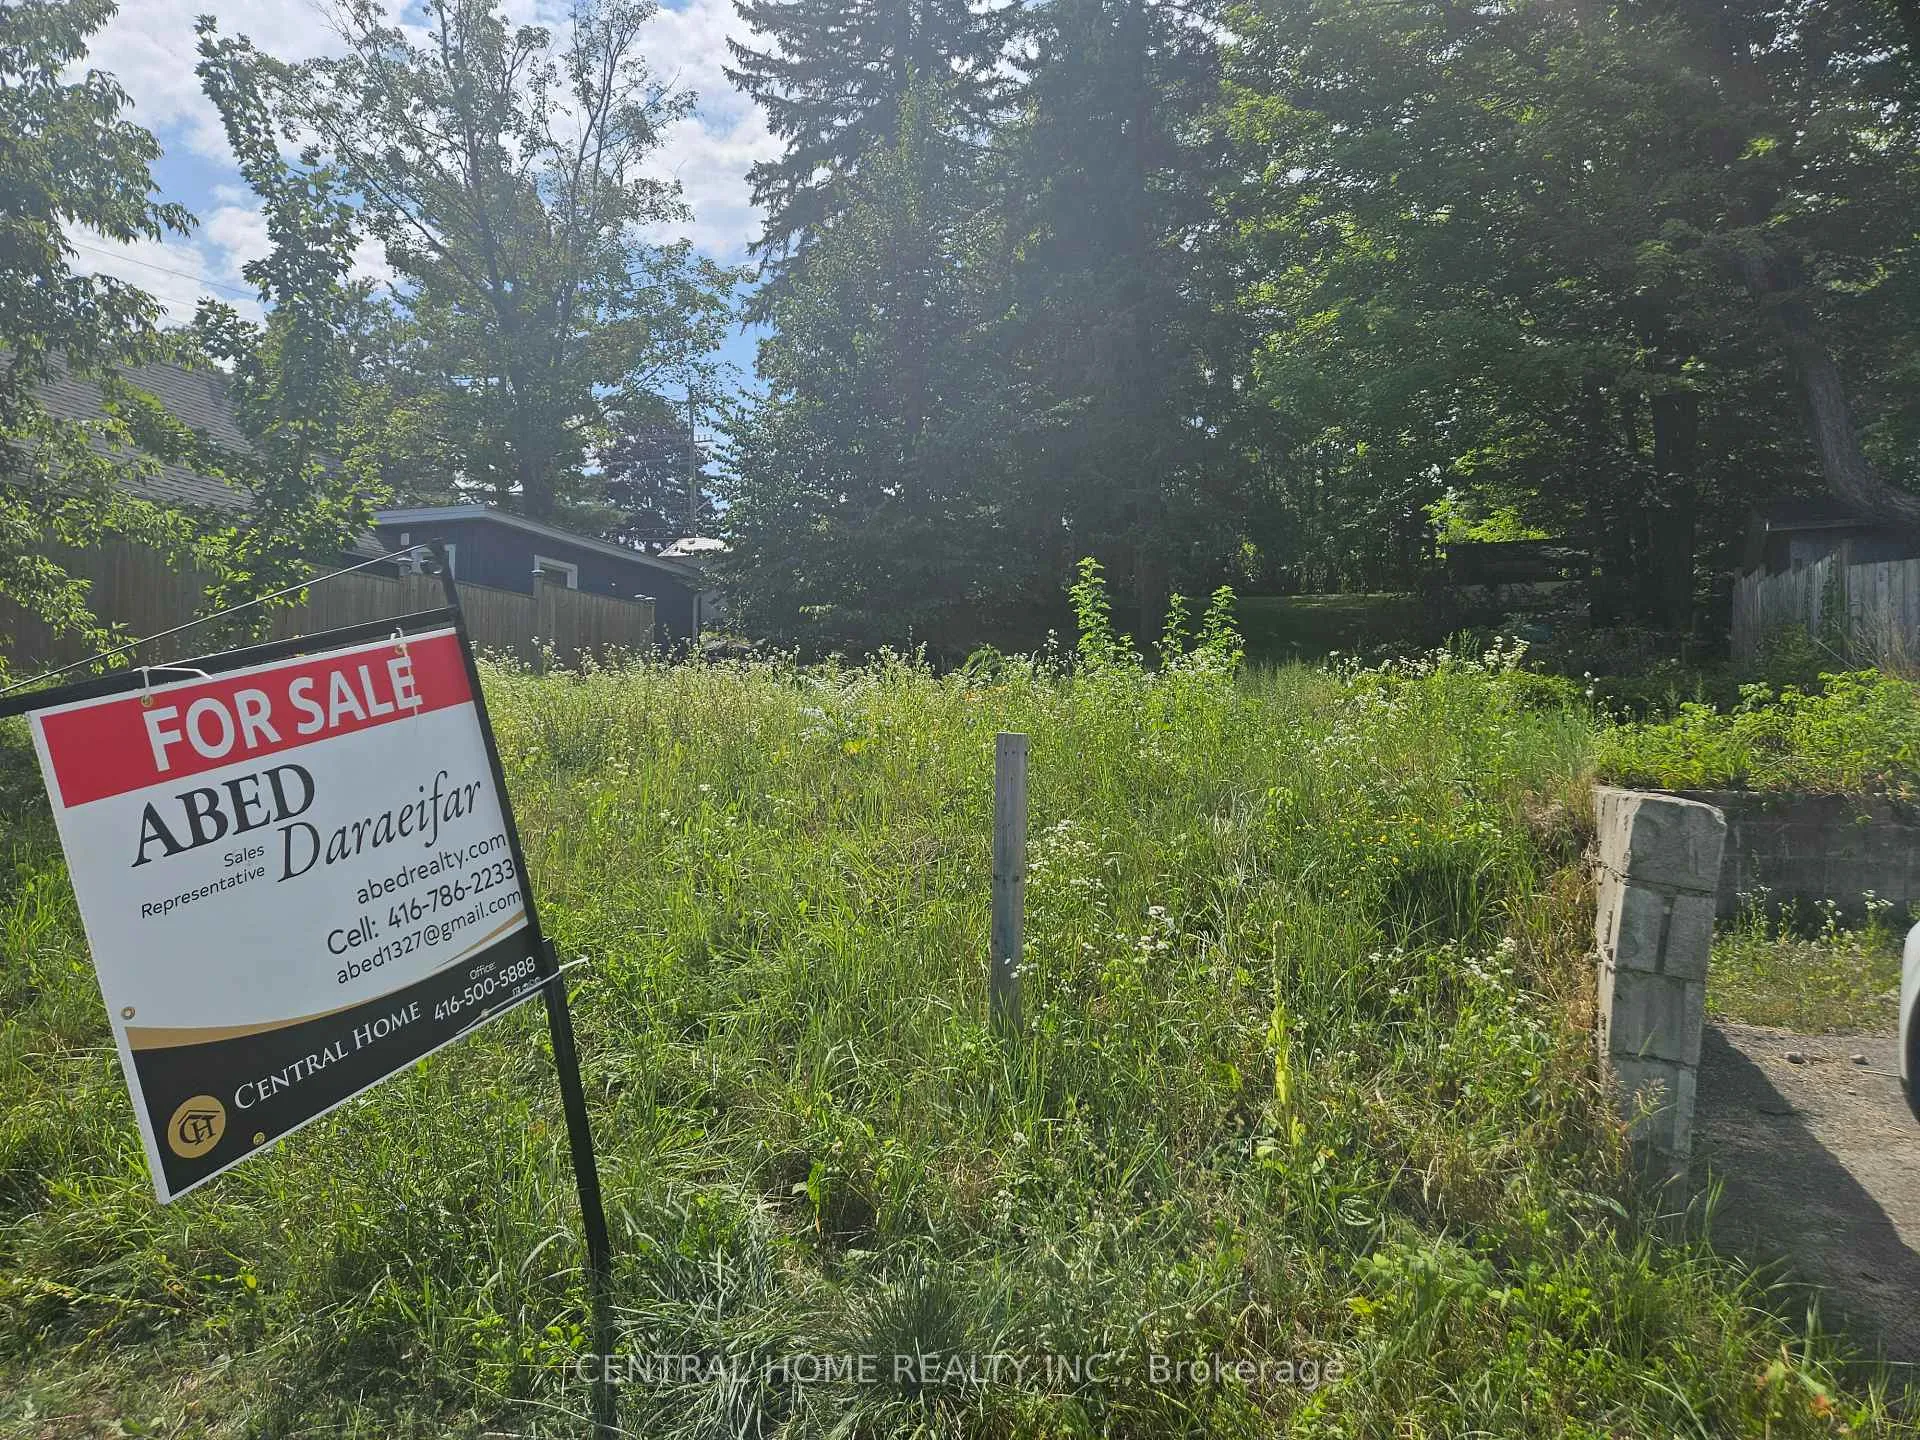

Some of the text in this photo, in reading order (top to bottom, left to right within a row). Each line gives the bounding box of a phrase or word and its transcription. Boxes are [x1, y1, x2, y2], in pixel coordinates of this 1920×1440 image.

[142, 655, 423, 773] FOR SALE
[130, 763, 315, 868] ABED
[223, 843, 266, 869] Sales
[276, 769, 481, 884] Daraeifar
[141, 864, 265, 919] Representative
[327, 859, 516, 956] Cell: 416-786-2233
[356, 833, 506, 905] abedrealty.com
[336, 889, 522, 984] abed1327@gmail.com
[434, 956, 536, 1021] 416-500-5888
[234, 1001, 421, 1110] CENTRAL HOME
